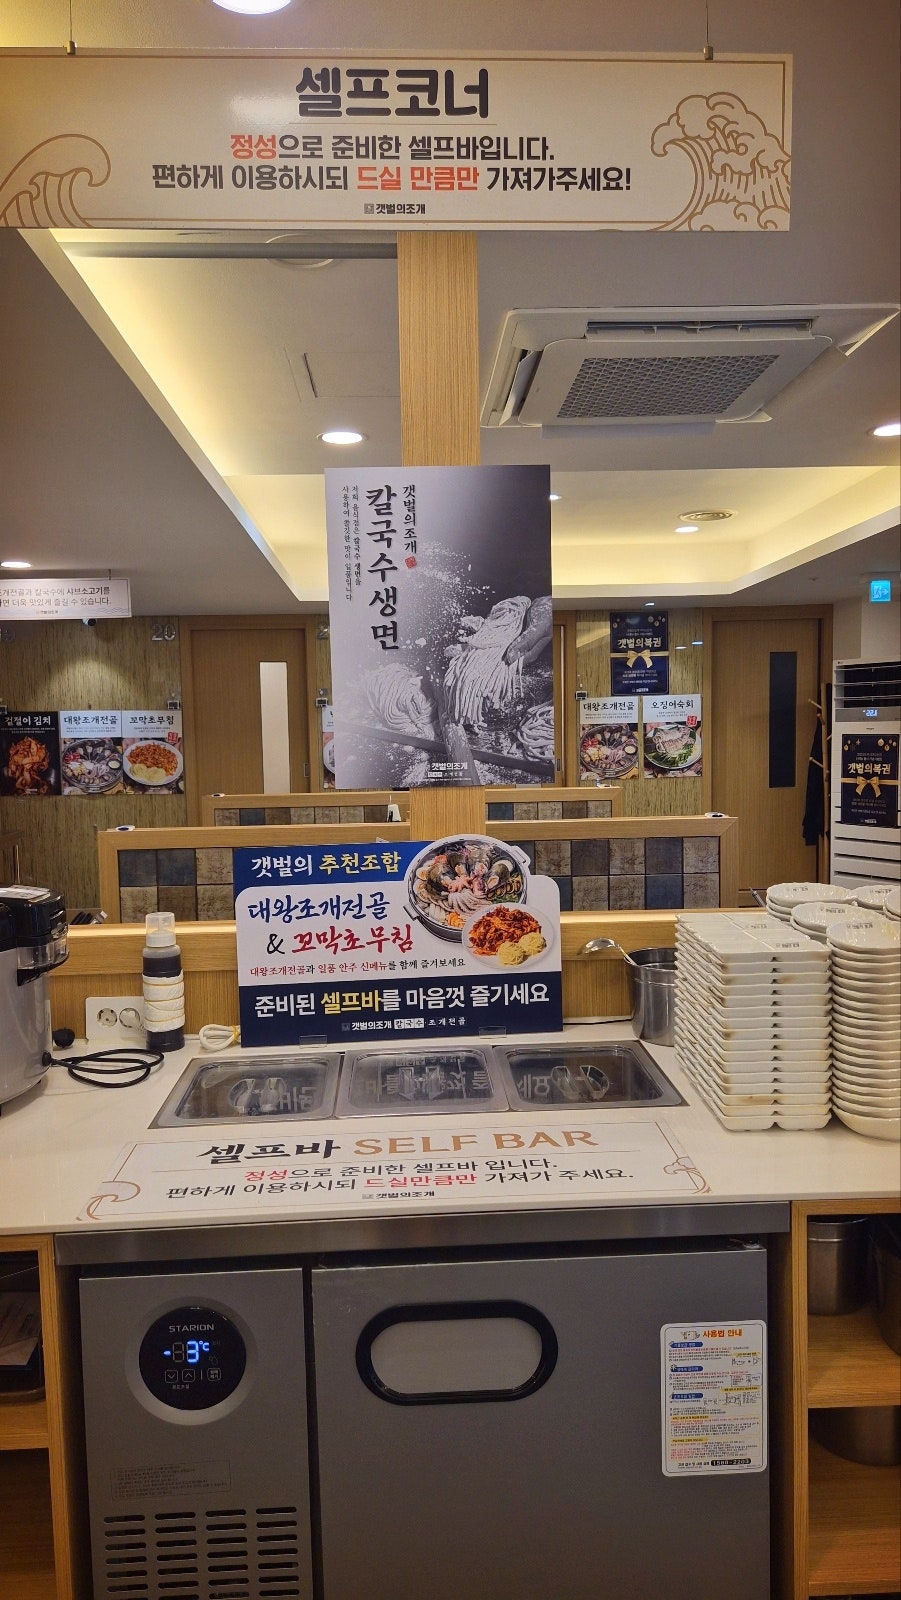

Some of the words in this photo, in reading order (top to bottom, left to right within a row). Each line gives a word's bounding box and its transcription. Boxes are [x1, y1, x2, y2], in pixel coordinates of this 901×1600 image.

[296, 67, 490, 118] 셀프코너
[230, 134, 324, 160] 정성으로
[332, 135, 401, 160] 준비한
[408, 135, 555, 161] 셀프바입니다.
[152, 165, 224, 190] 편하게
[231, 165, 349, 191] 이용하시되
[357, 166, 402, 191] 드실
[410, 166, 479, 192] 만큼만
[487, 166, 631, 192] 가져가주세요!
[375, 203, 426, 214] 갯벌의조개
[403, 484, 417, 554] 갯벌의조개
[366, 485, 399, 651] 칼국수생면
[151, 624, 177, 641] 20
[617, 637, 662, 649] 갯벌의복권
[583, 701, 635, 711] 대왕조개전골
[651, 699, 694, 709] 오징어숙회
[63, 715, 119, 726] 대왕조개전골
[130, 715, 175, 726] 꼬막초무침
[847, 762, 891, 775] 갯벌의복권
[251, 854, 313, 879] 갯벌의
[318, 852, 401, 875] 추천조합
[247, 892, 390, 924] 대왕조개전골
[266, 933, 285, 955] &
[291, 924, 414, 955] 꼬막초무침
[250, 964, 315, 977] 대왕조개전골과
[317, 963, 336, 974] 일품
[338, 962, 358, 973] 안주
[360, 961, 396, 972] 신메뉴를
[399, 959, 418, 970] 함께
[254, 991, 317, 1018] 준비된
[320, 989, 401, 1016] 셀프바를
[406, 985, 465, 1011] 마음껏
[469, 983, 550, 1009] 즐기세요
[351, 1020, 392, 1031] 갯벌의조개
[196, 1140, 341, 1164] 셀프바
[353, 1134, 478, 1155] SELF
[493, 1130, 599, 1150] BAR
[245, 1168, 332, 1181] 정성으로
[339, 1164, 405, 1177] 준비한
[413, 1161, 479, 1173] 셀프바
[484, 1158, 558, 1171] 입니다.
[166, 1185, 236, 1199] 편하게
[243, 1179, 356, 1194] 이용하시되
[364, 1173, 477, 1188] 드실만큼만
[484, 1171, 552, 1184] 가져가
[559, 1168, 634, 1181] 주세요.
[375, 1191, 435, 1200] 갯벌의조개
[169, 1323, 215, 1333] STARION
